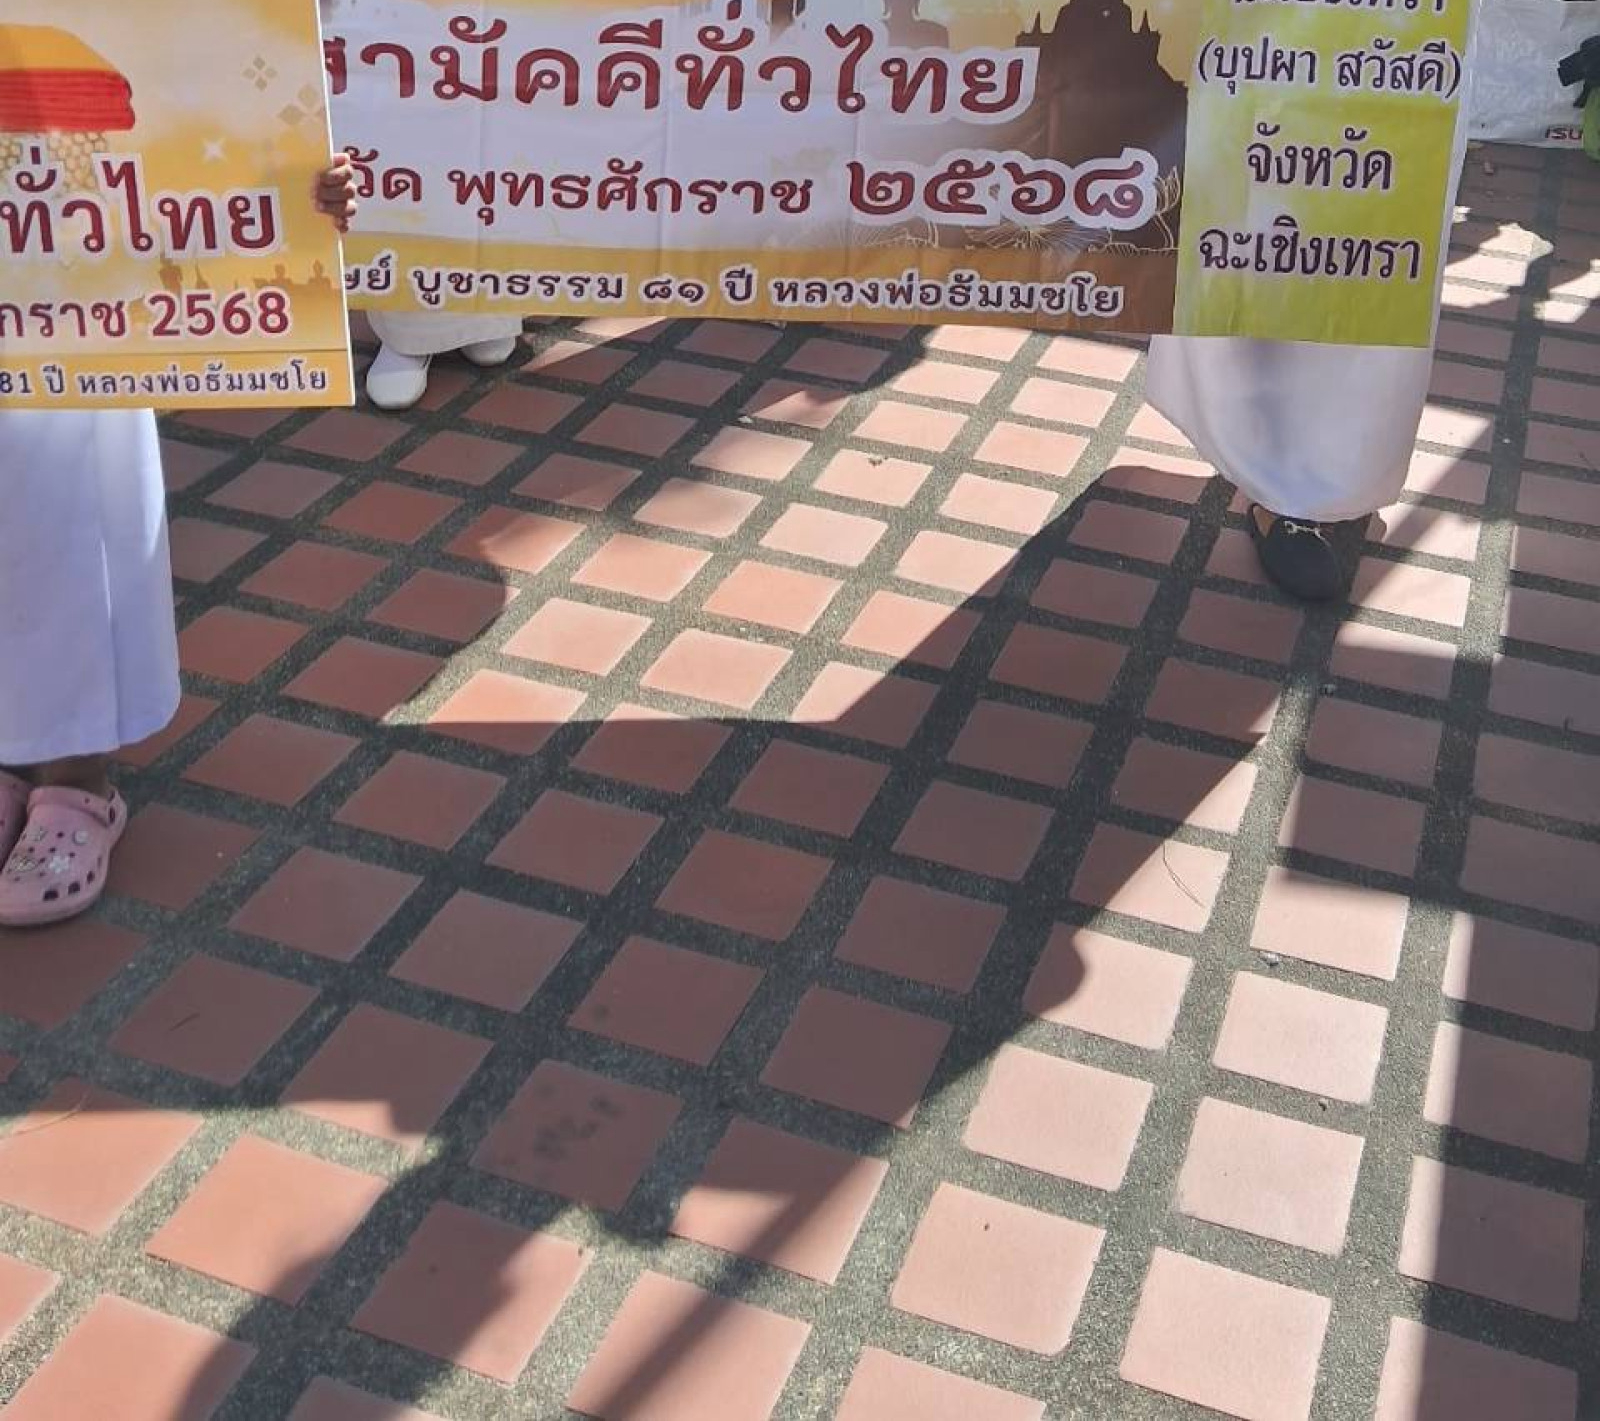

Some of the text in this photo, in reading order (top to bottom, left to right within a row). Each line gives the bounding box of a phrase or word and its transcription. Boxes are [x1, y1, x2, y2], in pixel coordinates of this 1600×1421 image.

[1198, 37, 1461, 99] (บุปผา สวัสดี)
[1246, 122, 1393, 190] จังหวัด
[447, 157, 813, 227] พุทธศักราช
[846, 158, 1145, 219] ๒๕๖๘
[1199, 215, 1421, 280] ฉะเชิงเทรา
[148, 291, 289, 337] 2568
[412, 268, 624, 305] บูชาธรรม
[724, 269, 754, 302] ปี
[773, 272, 1121, 313] หลวงพ่อธัมมชโย
[42, 364, 64, 394] ปี
